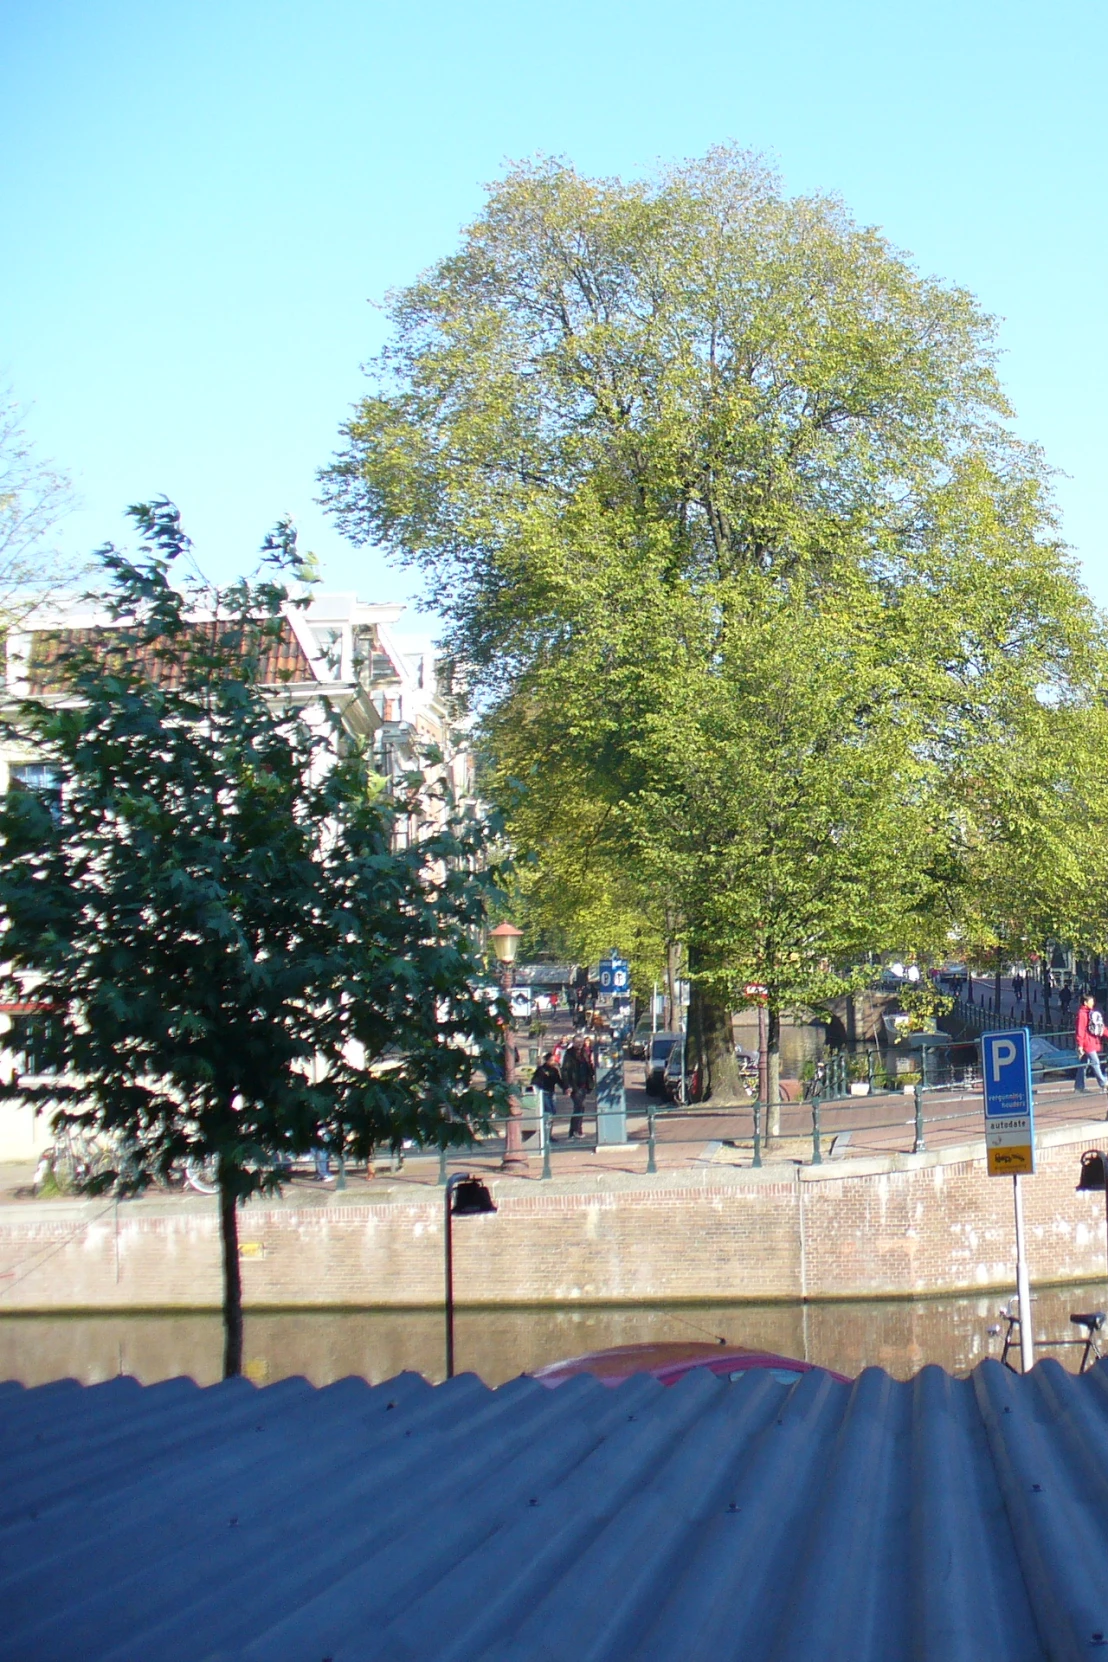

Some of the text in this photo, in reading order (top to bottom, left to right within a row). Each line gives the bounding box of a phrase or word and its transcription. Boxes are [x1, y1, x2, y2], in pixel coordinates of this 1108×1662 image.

[991, 1039, 1017, 1082] P
[1001, 1100, 1026, 1109] houders
[990, 1120, 1026, 1130] autodate
